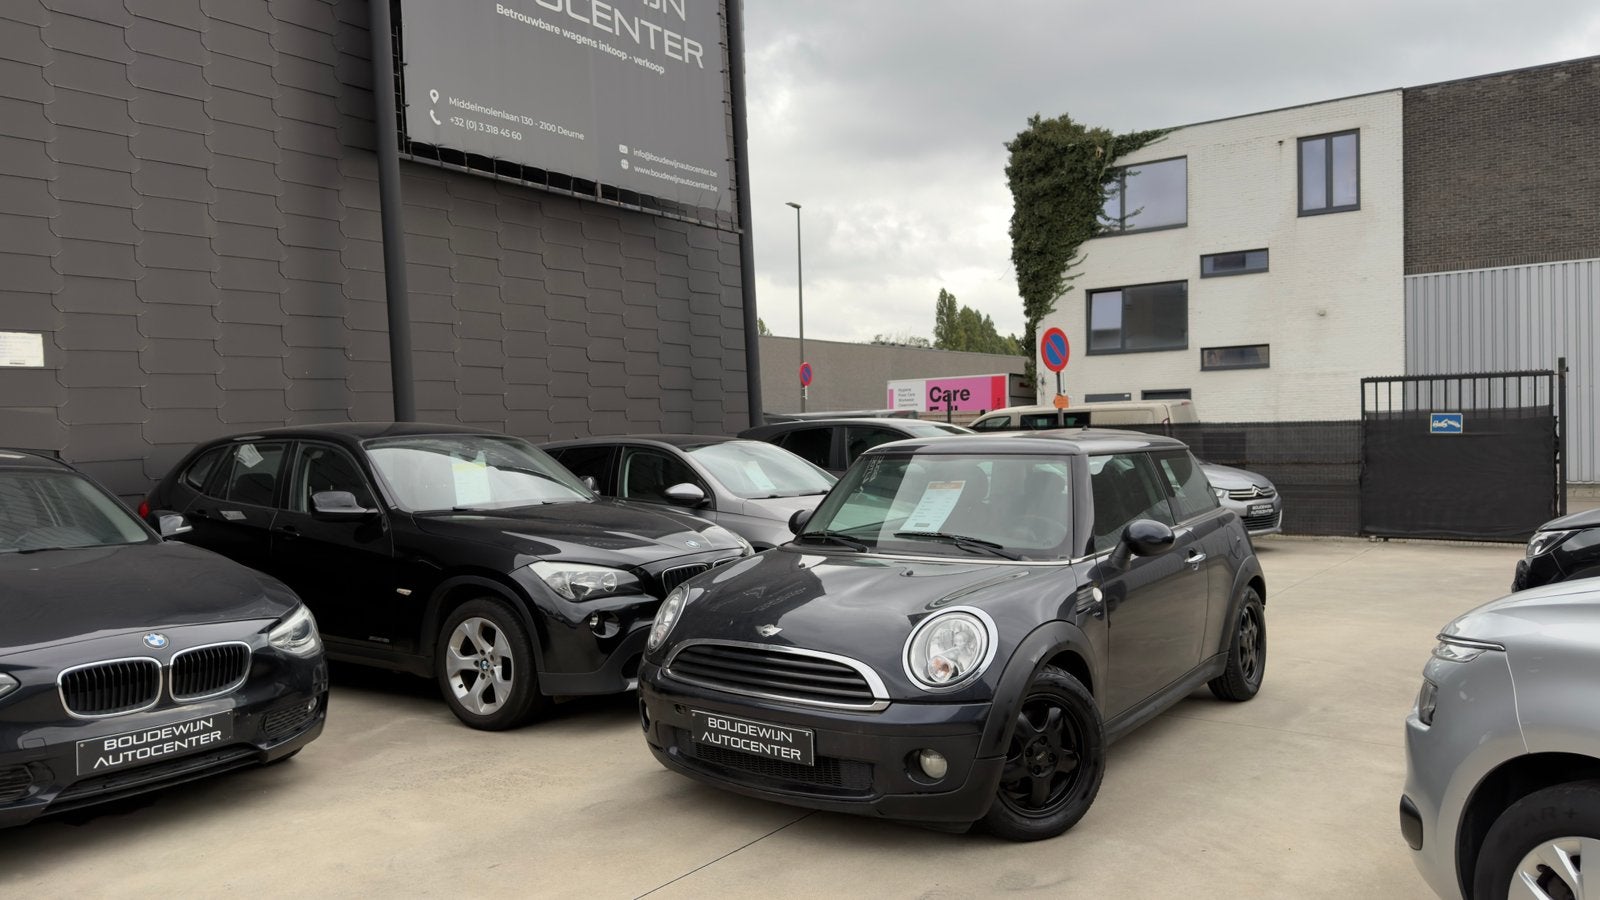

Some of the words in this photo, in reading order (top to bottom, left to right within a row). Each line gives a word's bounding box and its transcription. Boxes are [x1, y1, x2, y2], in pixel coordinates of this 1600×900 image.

[496, 3, 561, 35] Betrouwbare
[562, 28, 598, 48] wagens
[599, 40, 628, 61] inkoop
[633, 54, 665, 75] verkoop
[449, 97, 520, 122] Middelmolenlaan
[520, 115, 534, 127] 130
[539, 121, 556, 132] 2100
[557, 126, 585, 140] Deurne
[450, 116, 465, 128] +32
[466, 119, 477, 131] (0)
[478, 122, 484, 131] 3
[485, 123, 499, 135] 318
[500, 128, 510, 138] 45
[511, 131, 522, 141] 60
[929, 386, 971, 403] Care
[104, 717, 214, 751] BOUDEWIJN
[702, 731, 801, 760] AUTOCENTER
[708, 717, 793, 743] BOUDEWIJN
[93, 730, 222, 769] AUTOCENTER
